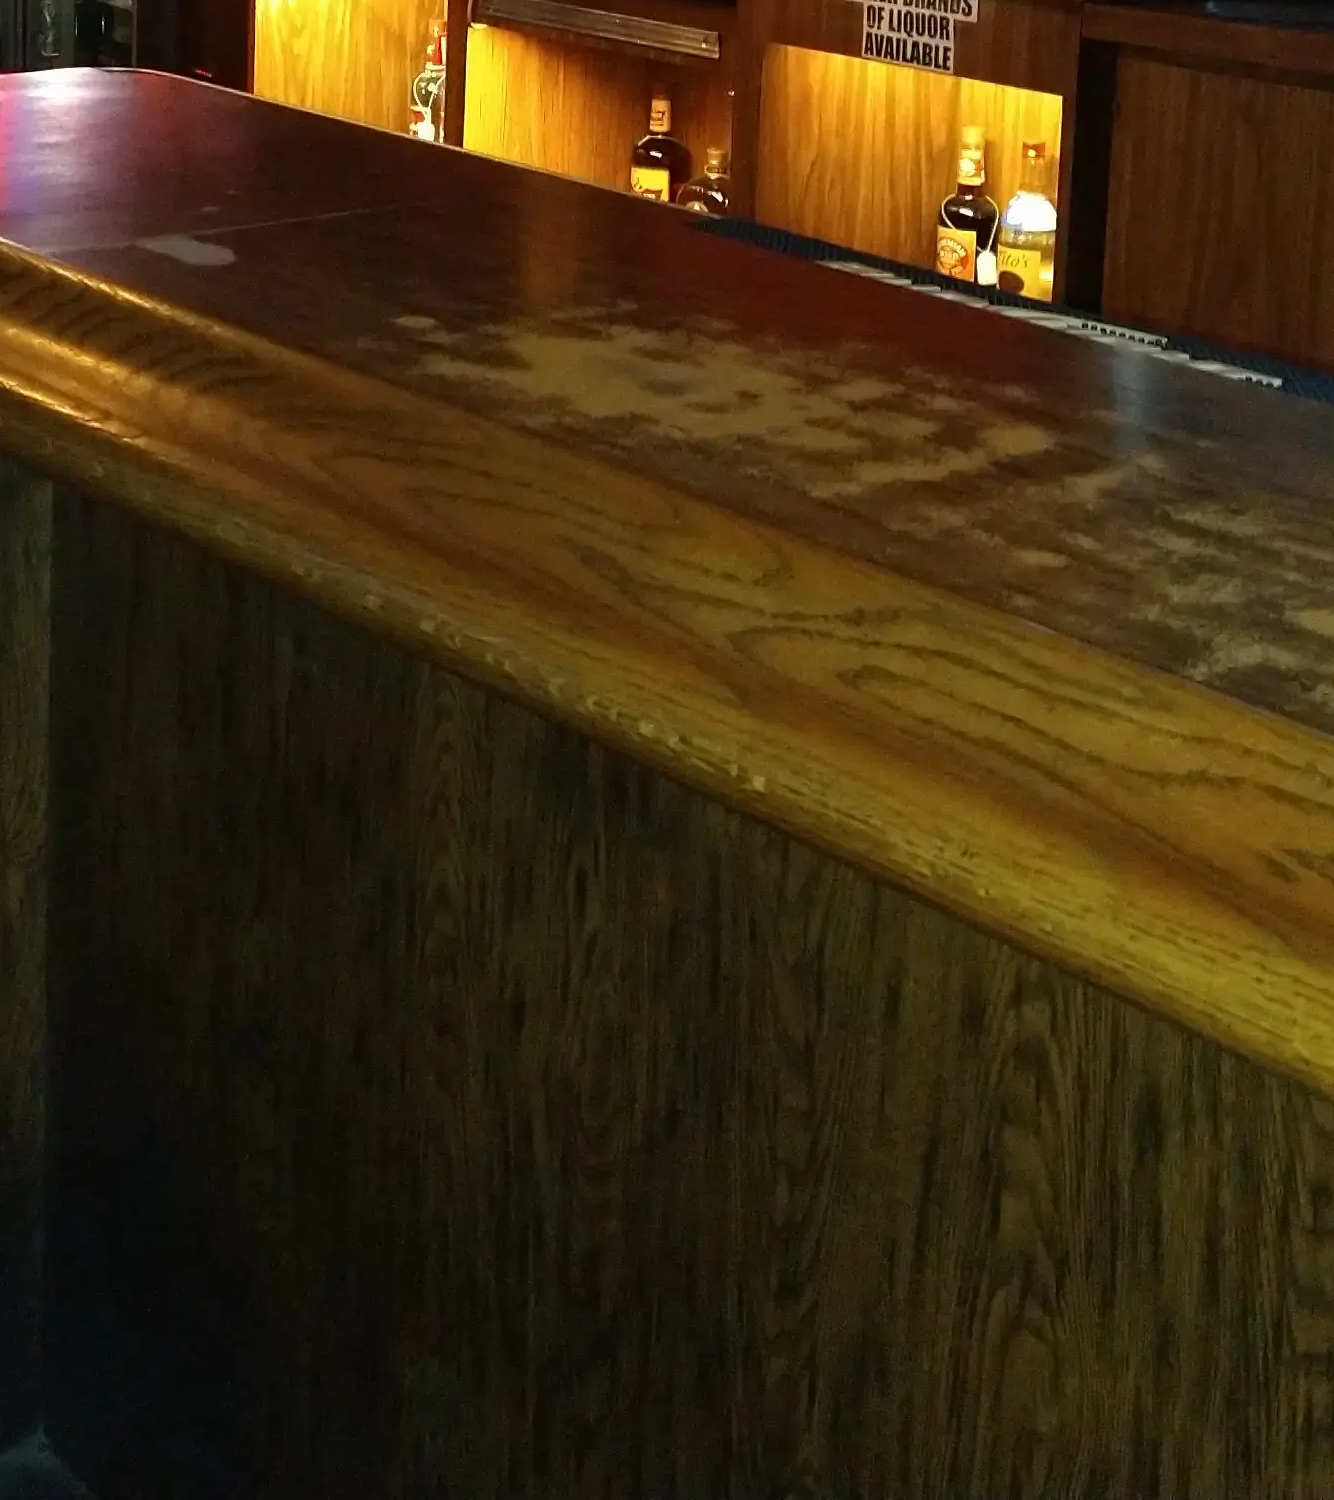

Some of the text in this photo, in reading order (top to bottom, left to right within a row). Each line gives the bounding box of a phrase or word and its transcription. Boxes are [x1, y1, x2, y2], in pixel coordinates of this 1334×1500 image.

[866, 5, 950, 41] OF LIQUOR
[863, 32, 952, 71] AVAILABLE
